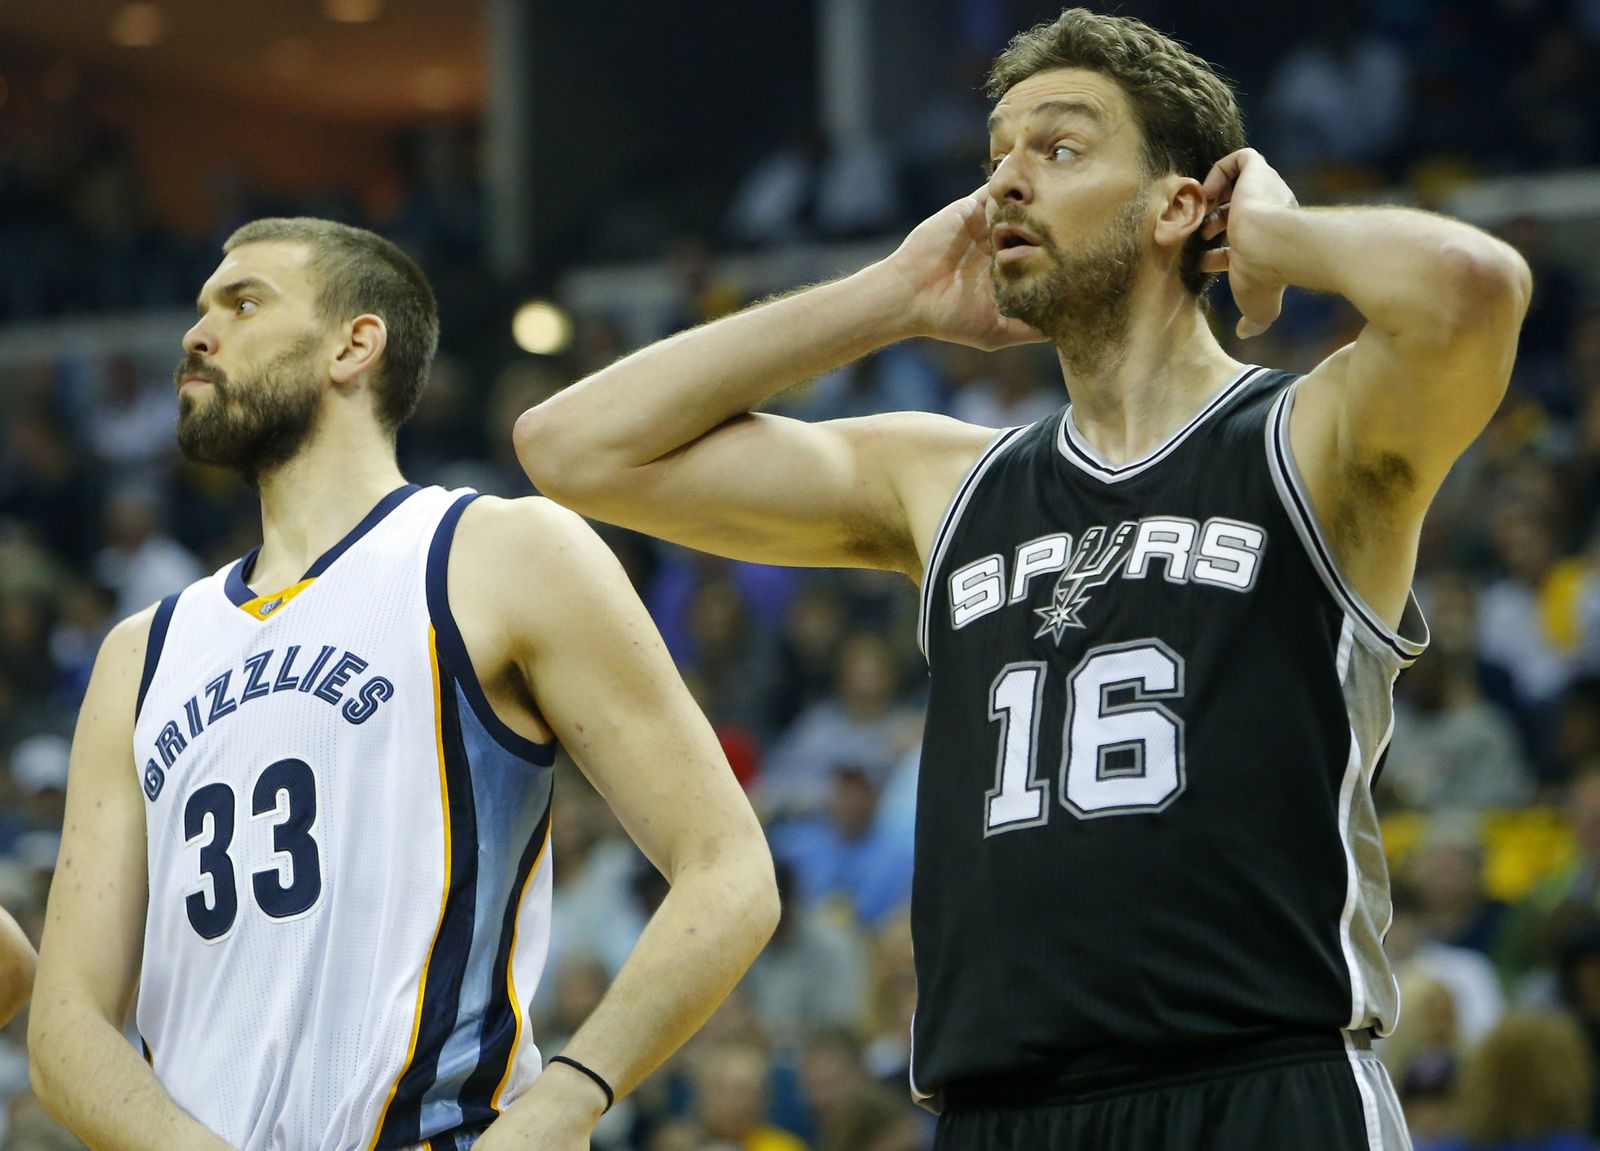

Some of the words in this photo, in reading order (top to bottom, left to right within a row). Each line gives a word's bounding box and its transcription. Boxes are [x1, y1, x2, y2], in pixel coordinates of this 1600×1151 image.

[948, 515, 1266, 642] SPURS
[143, 645, 395, 802] GRIZZLIES
[984, 637, 1187, 838] 16
[184, 757, 324, 942] 33
